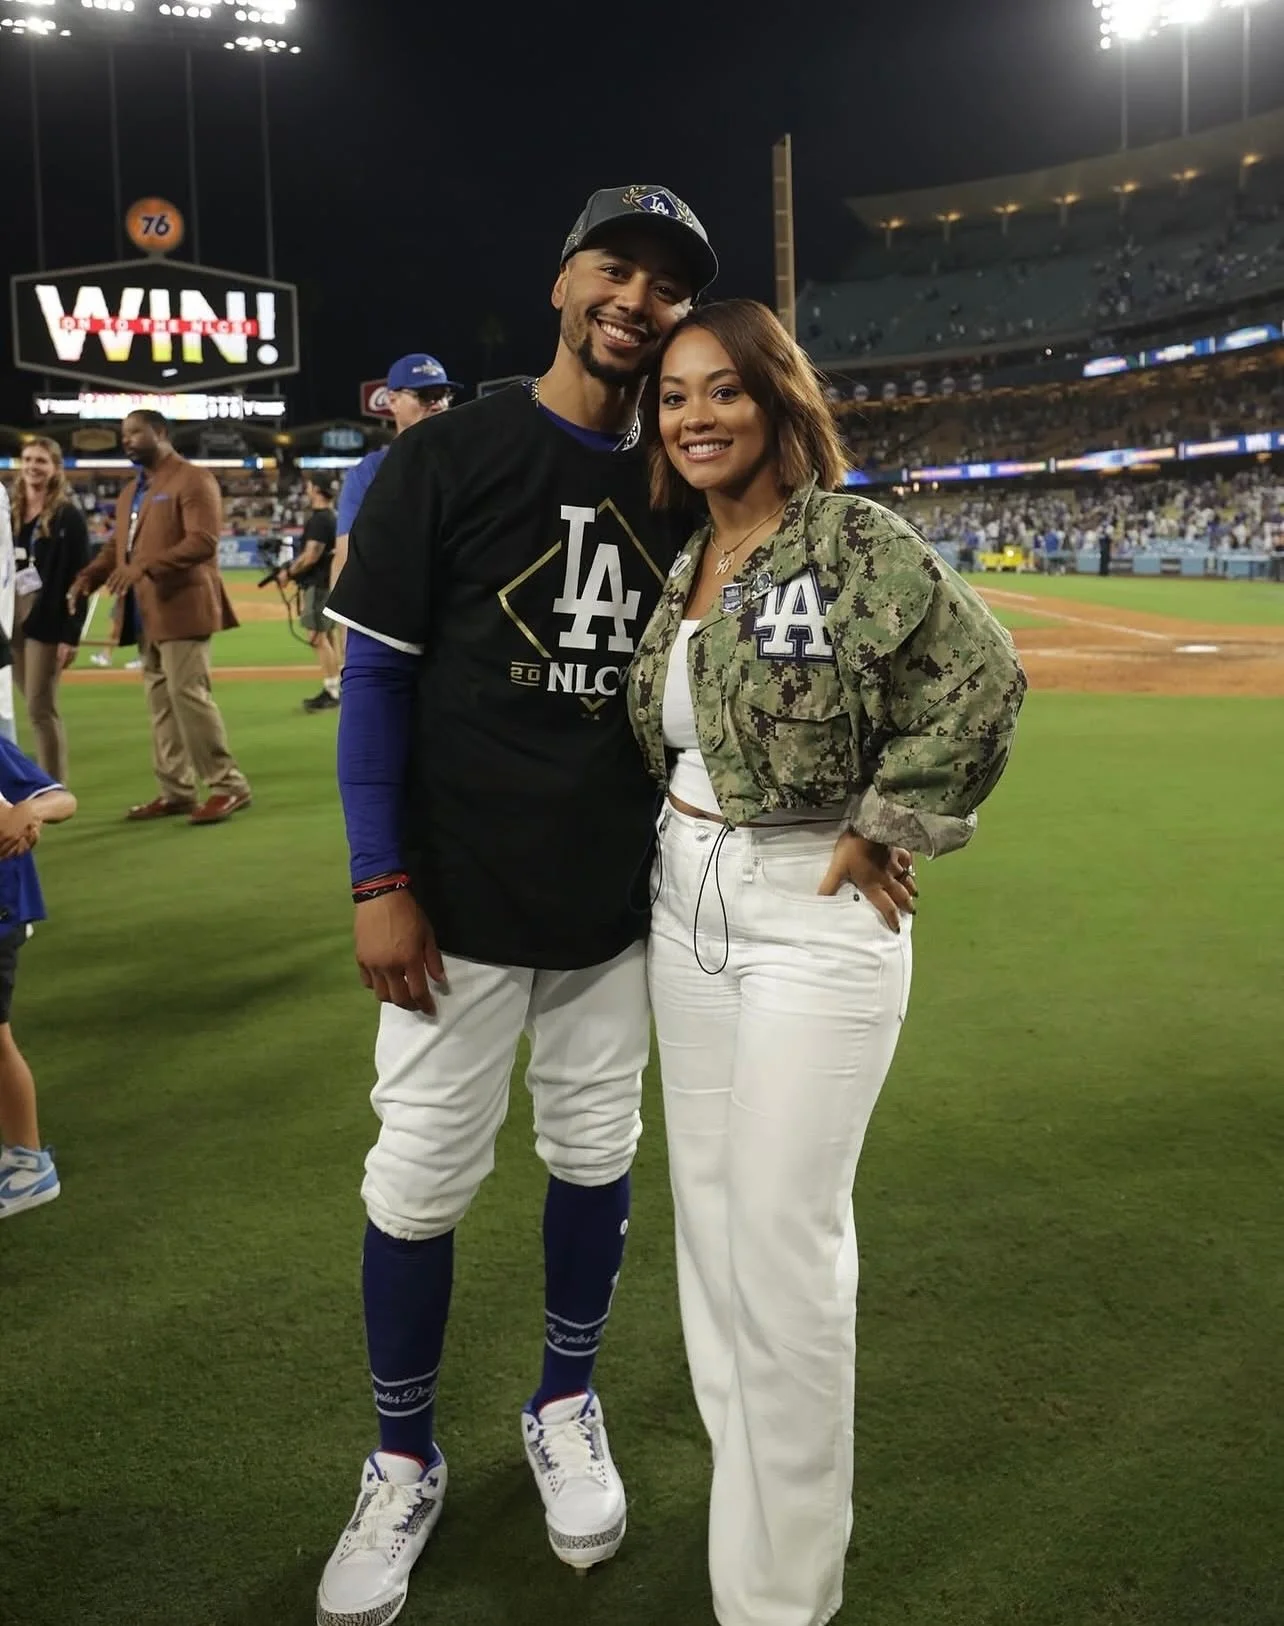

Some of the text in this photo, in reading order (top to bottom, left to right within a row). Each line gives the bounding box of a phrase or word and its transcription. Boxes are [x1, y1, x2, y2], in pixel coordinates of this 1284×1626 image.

[141, 214, 171, 237] 76
[35, 284, 279, 364] WIN!
[61, 316, 91, 332] ON
[102, 317, 129, 333] TO
[141, 318, 180, 334] THE
[552, 504, 642, 653] LA
[754, 568, 837, 658] LA
[546, 661, 628, 696] NLC
